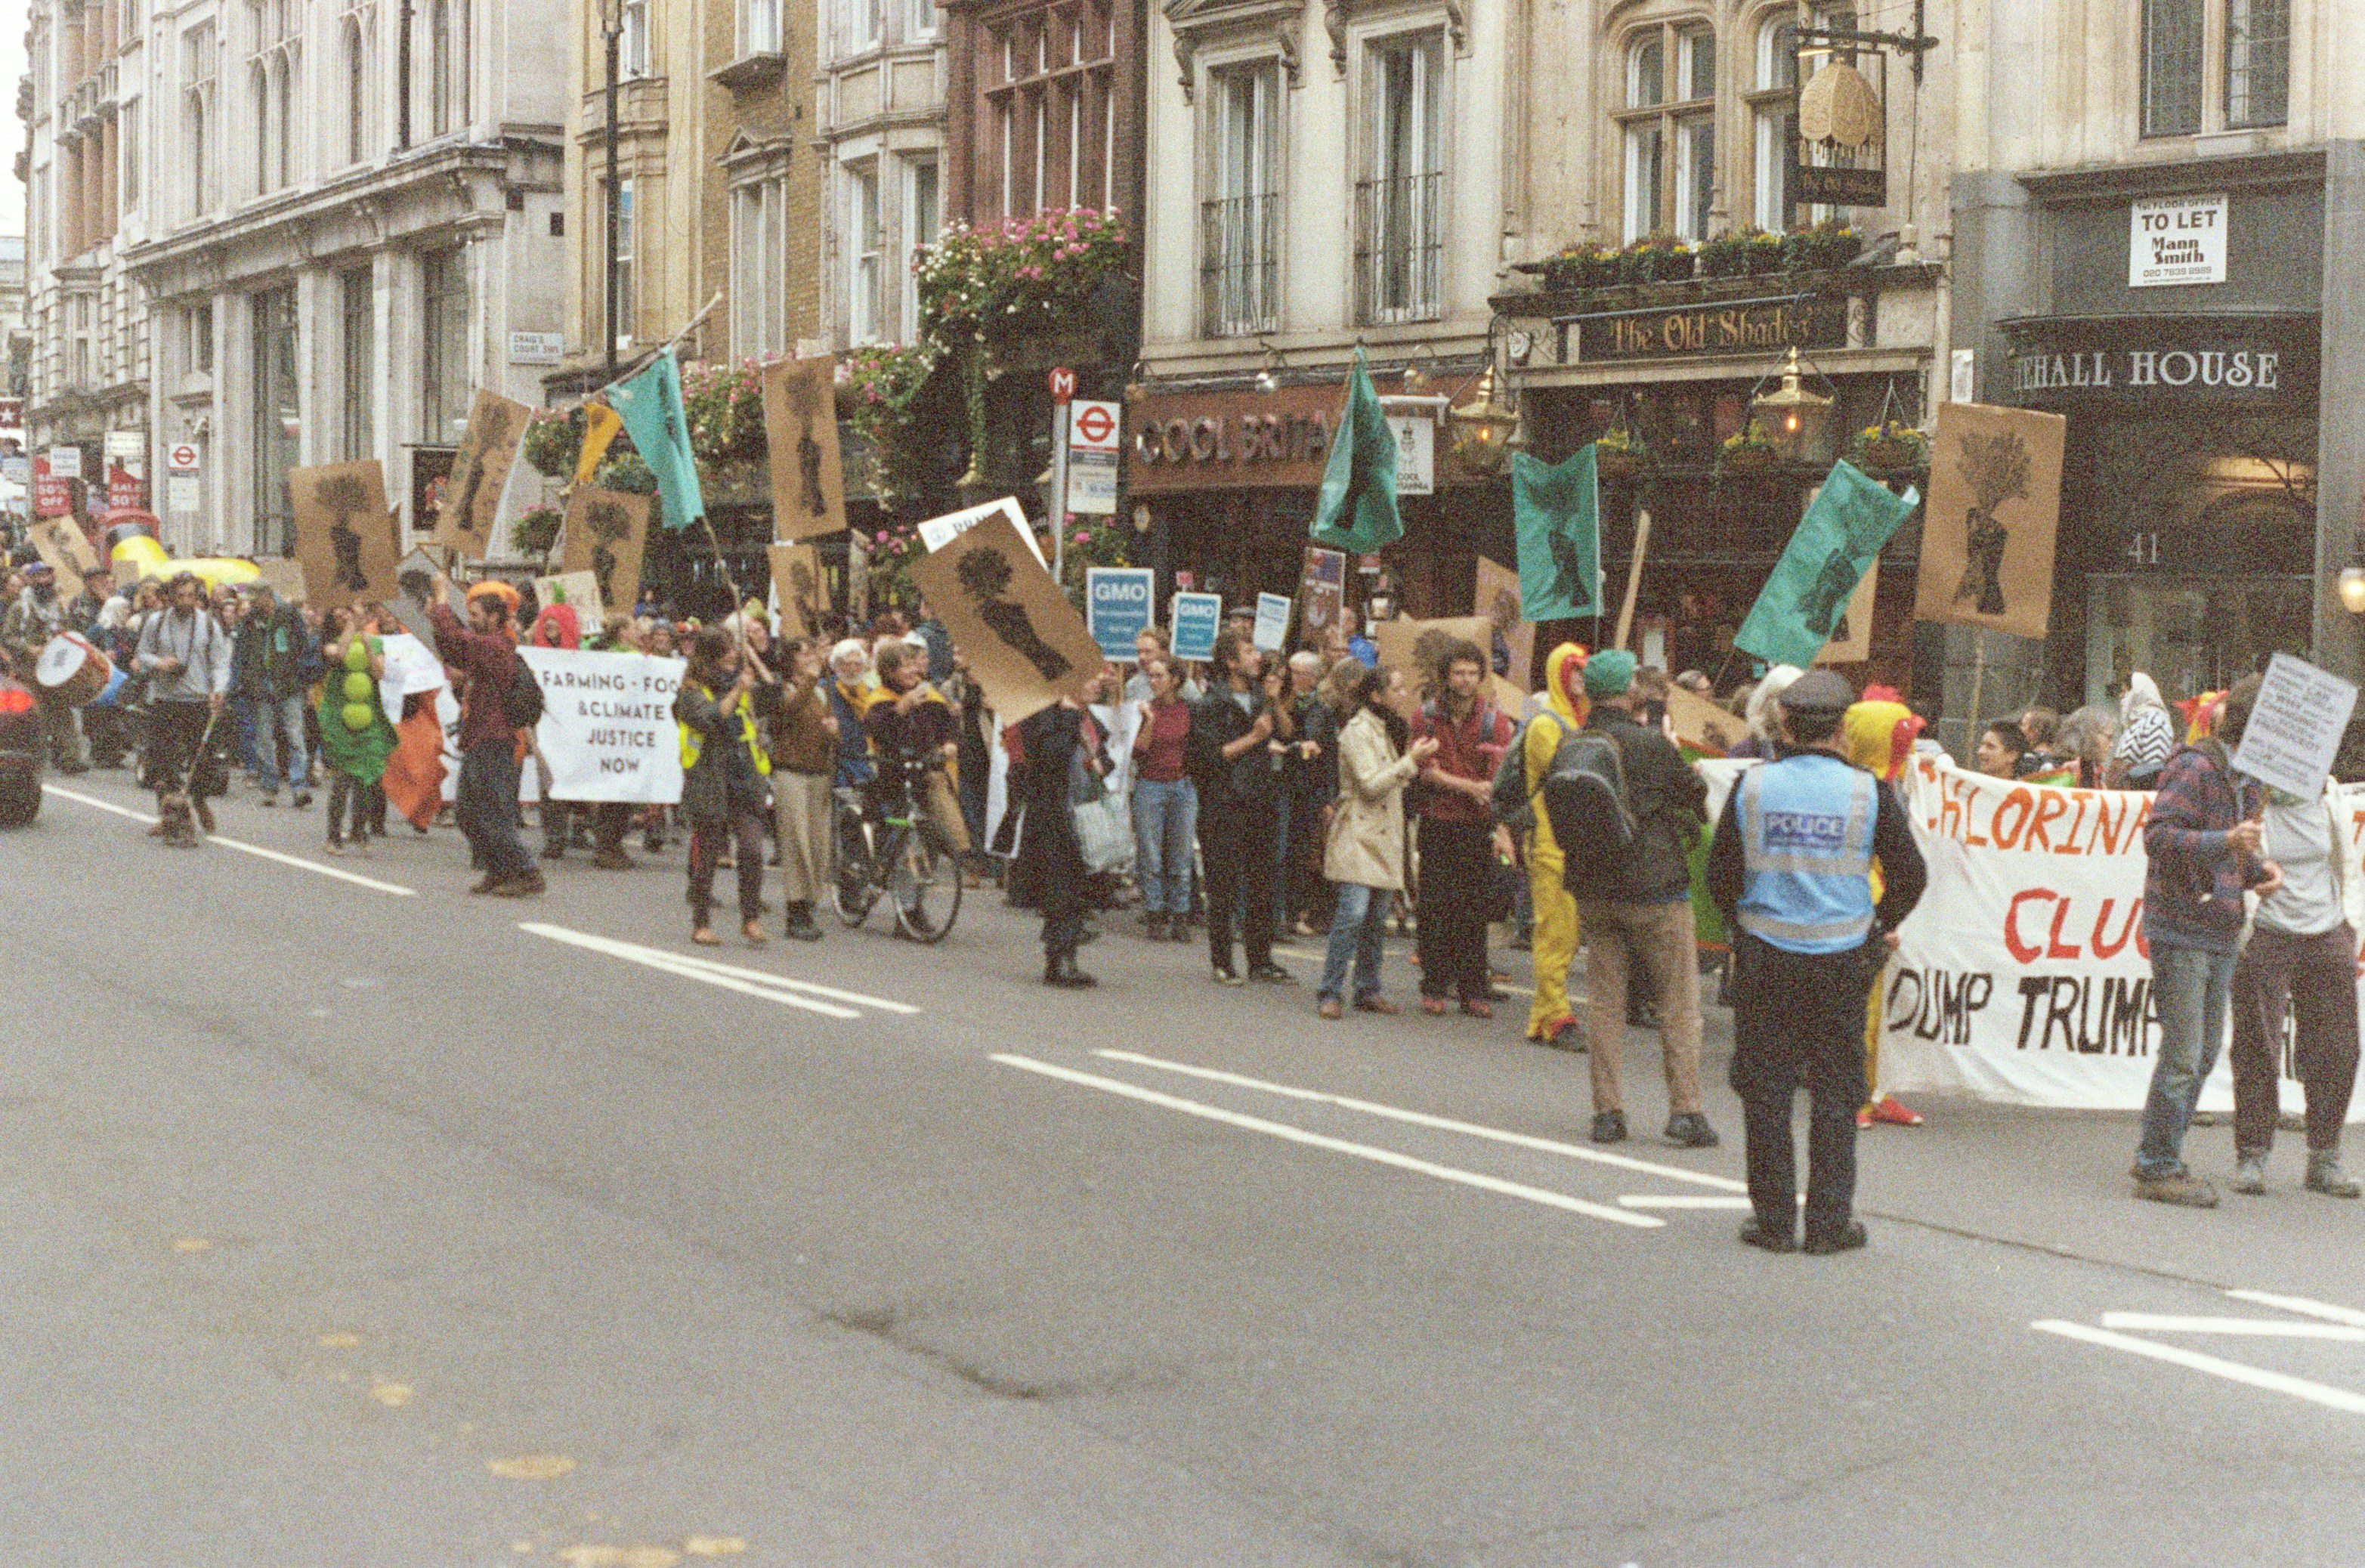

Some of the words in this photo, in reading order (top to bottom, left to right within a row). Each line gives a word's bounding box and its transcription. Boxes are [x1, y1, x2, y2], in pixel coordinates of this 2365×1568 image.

[2141, 213, 2169, 231] TO
[2177, 209, 2218, 229] LET
[2152, 237, 2199, 250] Mann
[2154, 249, 2204, 264] Smith
[2143, 268, 2161, 277] 020
[1612, 318, 1654, 352] The
[1664, 314, 1705, 351] Old
[2128, 351, 2279, 389] HOUSE
[1054, 373, 1074, 394] M
[2128, 532, 2159, 564] 41
[1096, 583, 1147, 602] GMO
[1179, 602, 1216, 618] GMO
[543, 670, 626, 691] FARMING
[586, 729, 656, 748] JUSTICE
[600, 757, 641, 775] NOW
[1768, 814, 1847, 837] POLICE
[1887, 967, 1994, 1045] DUMP
